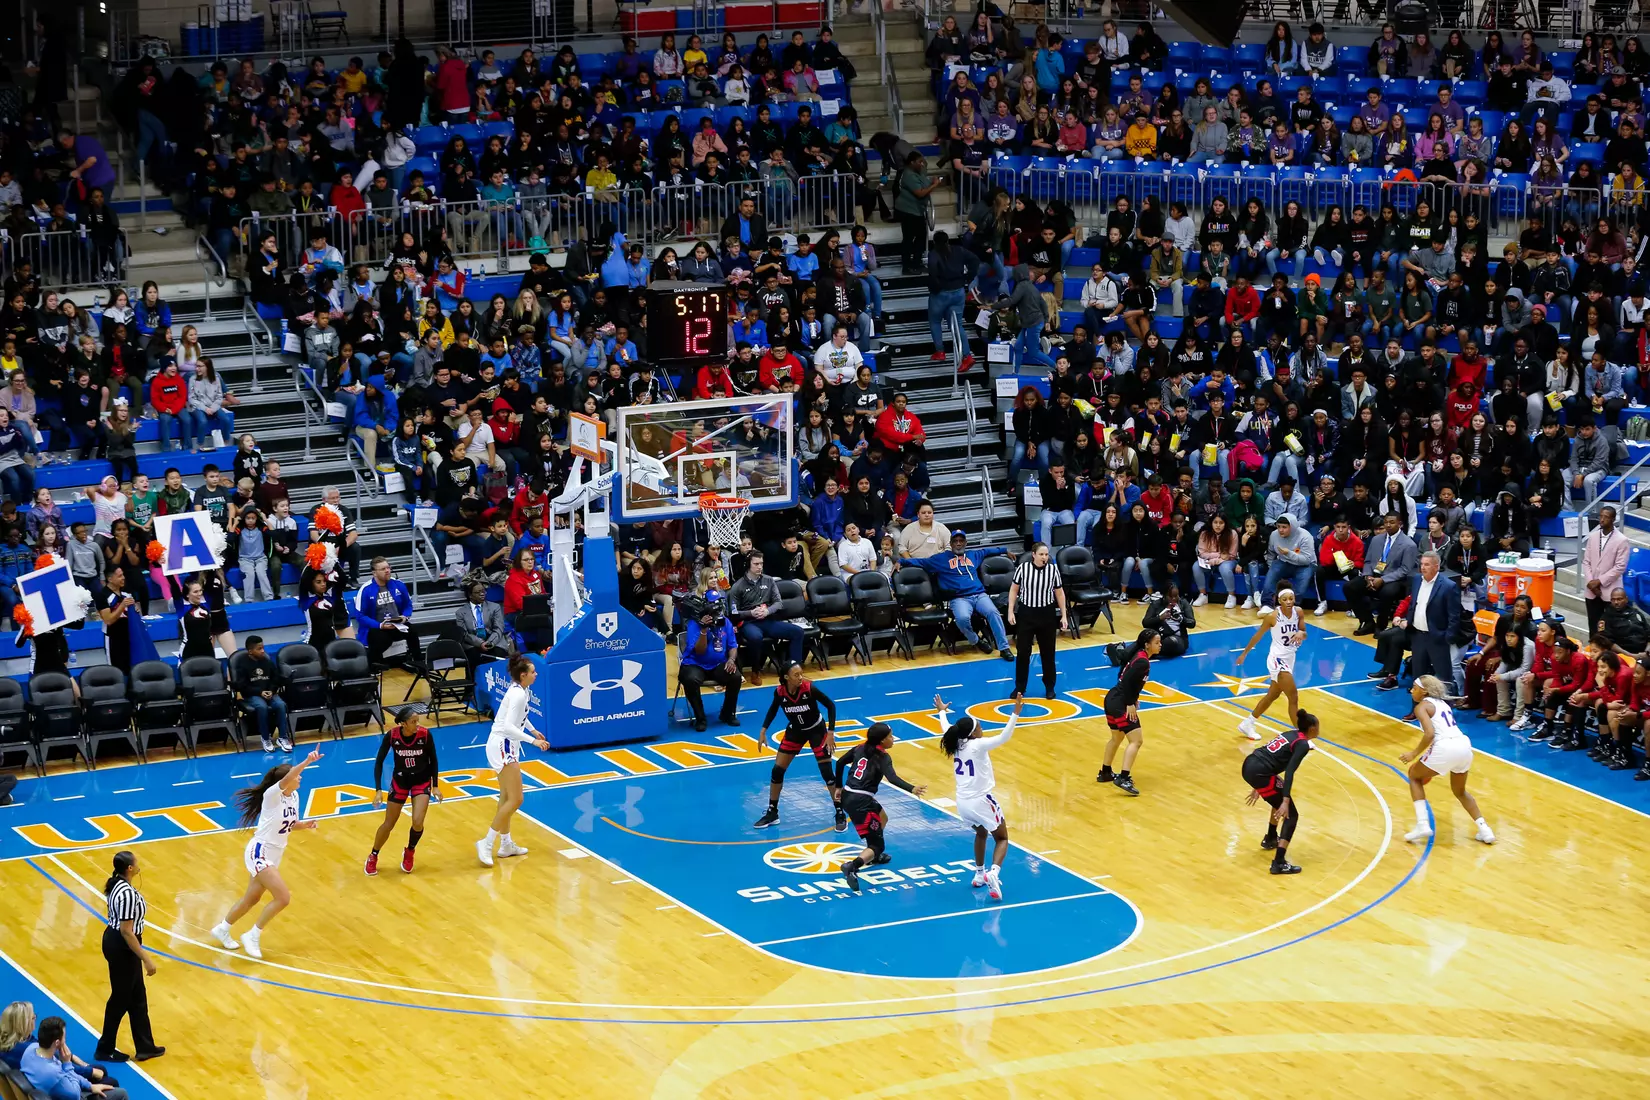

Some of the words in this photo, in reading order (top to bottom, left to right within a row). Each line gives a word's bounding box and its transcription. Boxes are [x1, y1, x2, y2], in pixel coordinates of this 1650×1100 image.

[1410, 228, 1431, 237] BEAR
[675, 293, 720, 316] 5:17
[686, 317, 711, 354] 12
[1454, 402, 1472, 410] POLO
[168, 517, 216, 571] A
[948, 555, 975, 570] UTA
[21, 565, 70, 626] T
[1280, 623, 1297, 635] UTA
[585, 638, 630, 650] emergency
[573, 715, 604, 725] UNDER
[606, 709, 645, 721] ARMOUR
[785, 704, 811, 714] LOUISIANA
[395, 749, 424, 757] LOUISIANA
[404, 758, 416, 768] 11
[853, 757, 868, 780] 2
[954, 757, 975, 777] 21
[11, 800, 227, 850] UT
[803, 875, 962, 905] CONFERENCE
